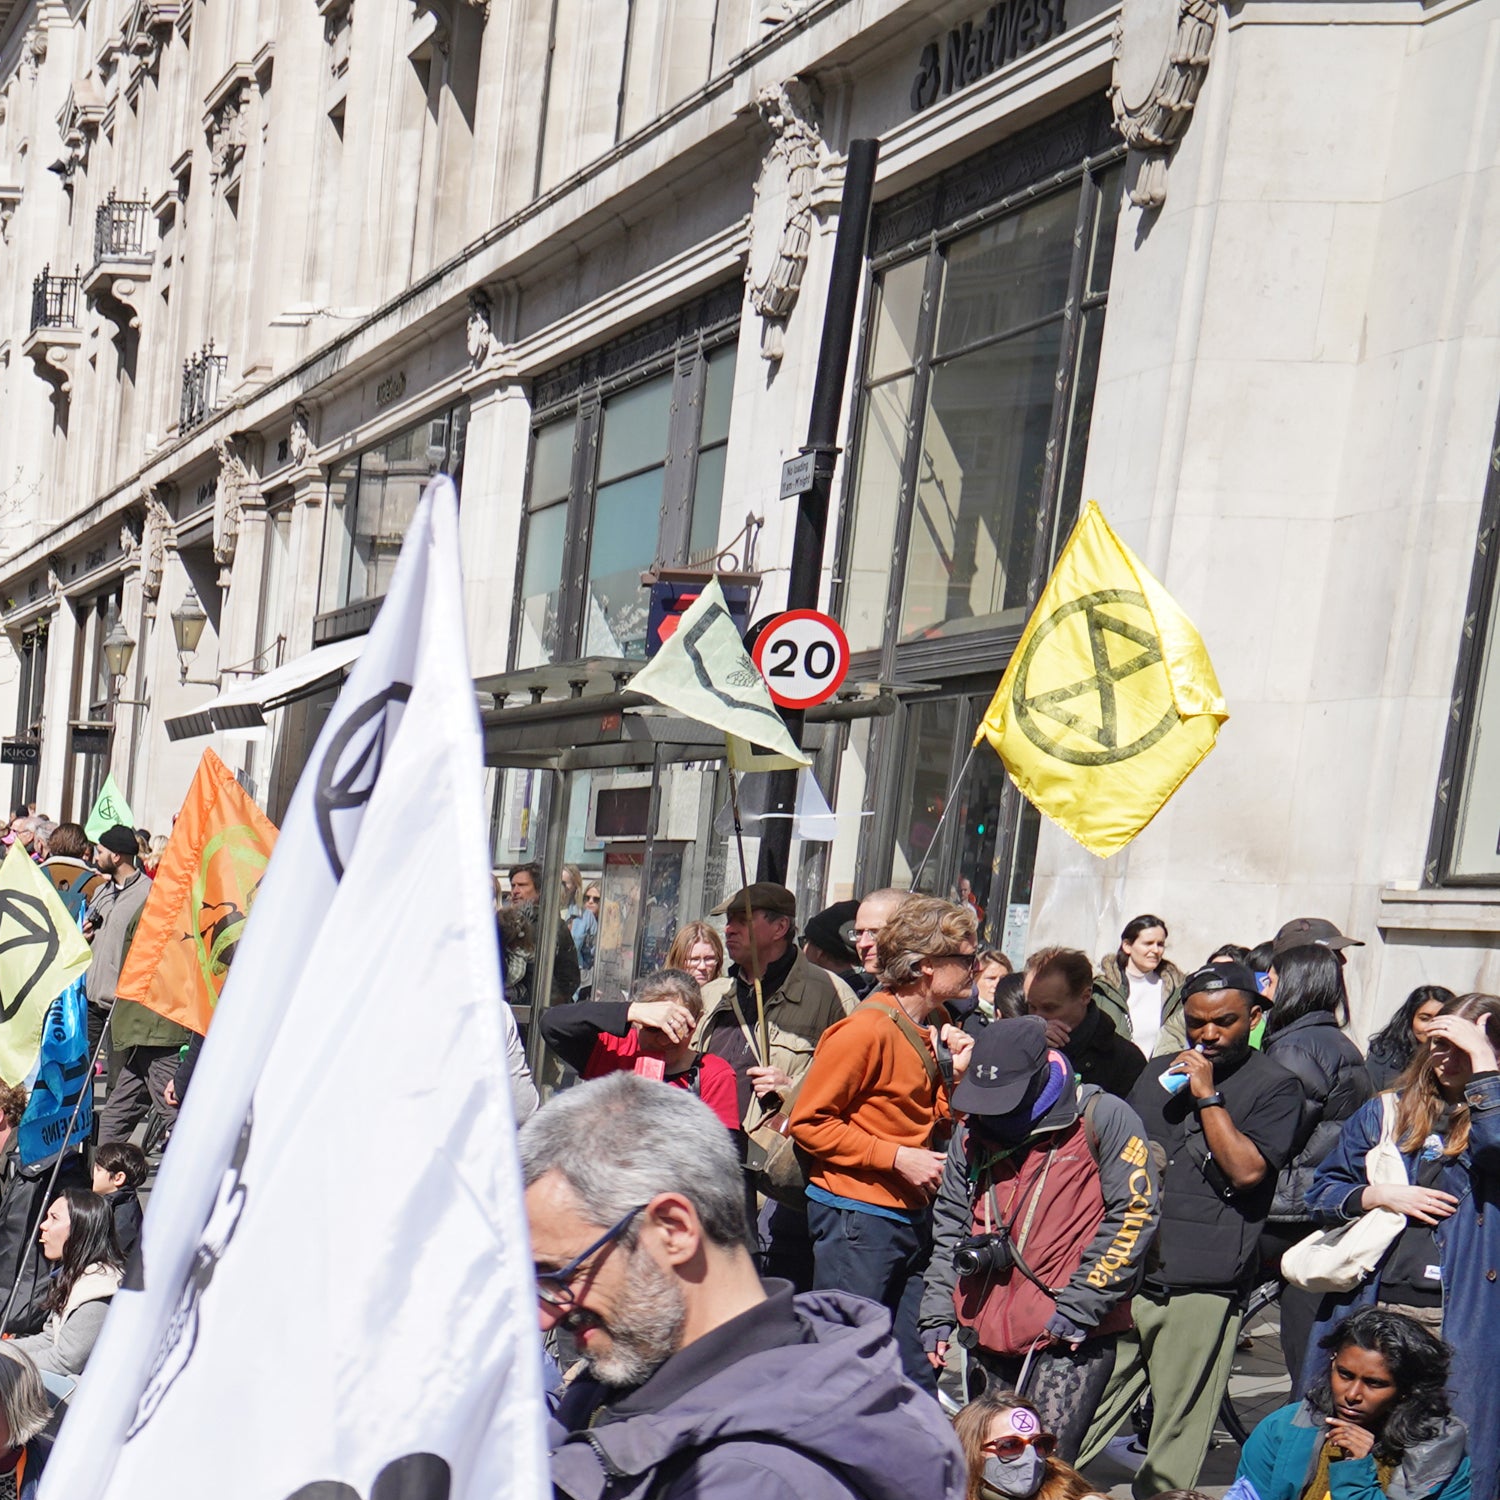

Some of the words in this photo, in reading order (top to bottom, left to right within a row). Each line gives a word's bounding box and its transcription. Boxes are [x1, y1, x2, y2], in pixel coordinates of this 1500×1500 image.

[942, 0, 1067, 96] NatWest
[768, 638, 836, 680] 20
[2, 747, 37, 758] KIKO
[1086, 1167, 1153, 1289] Columbia
